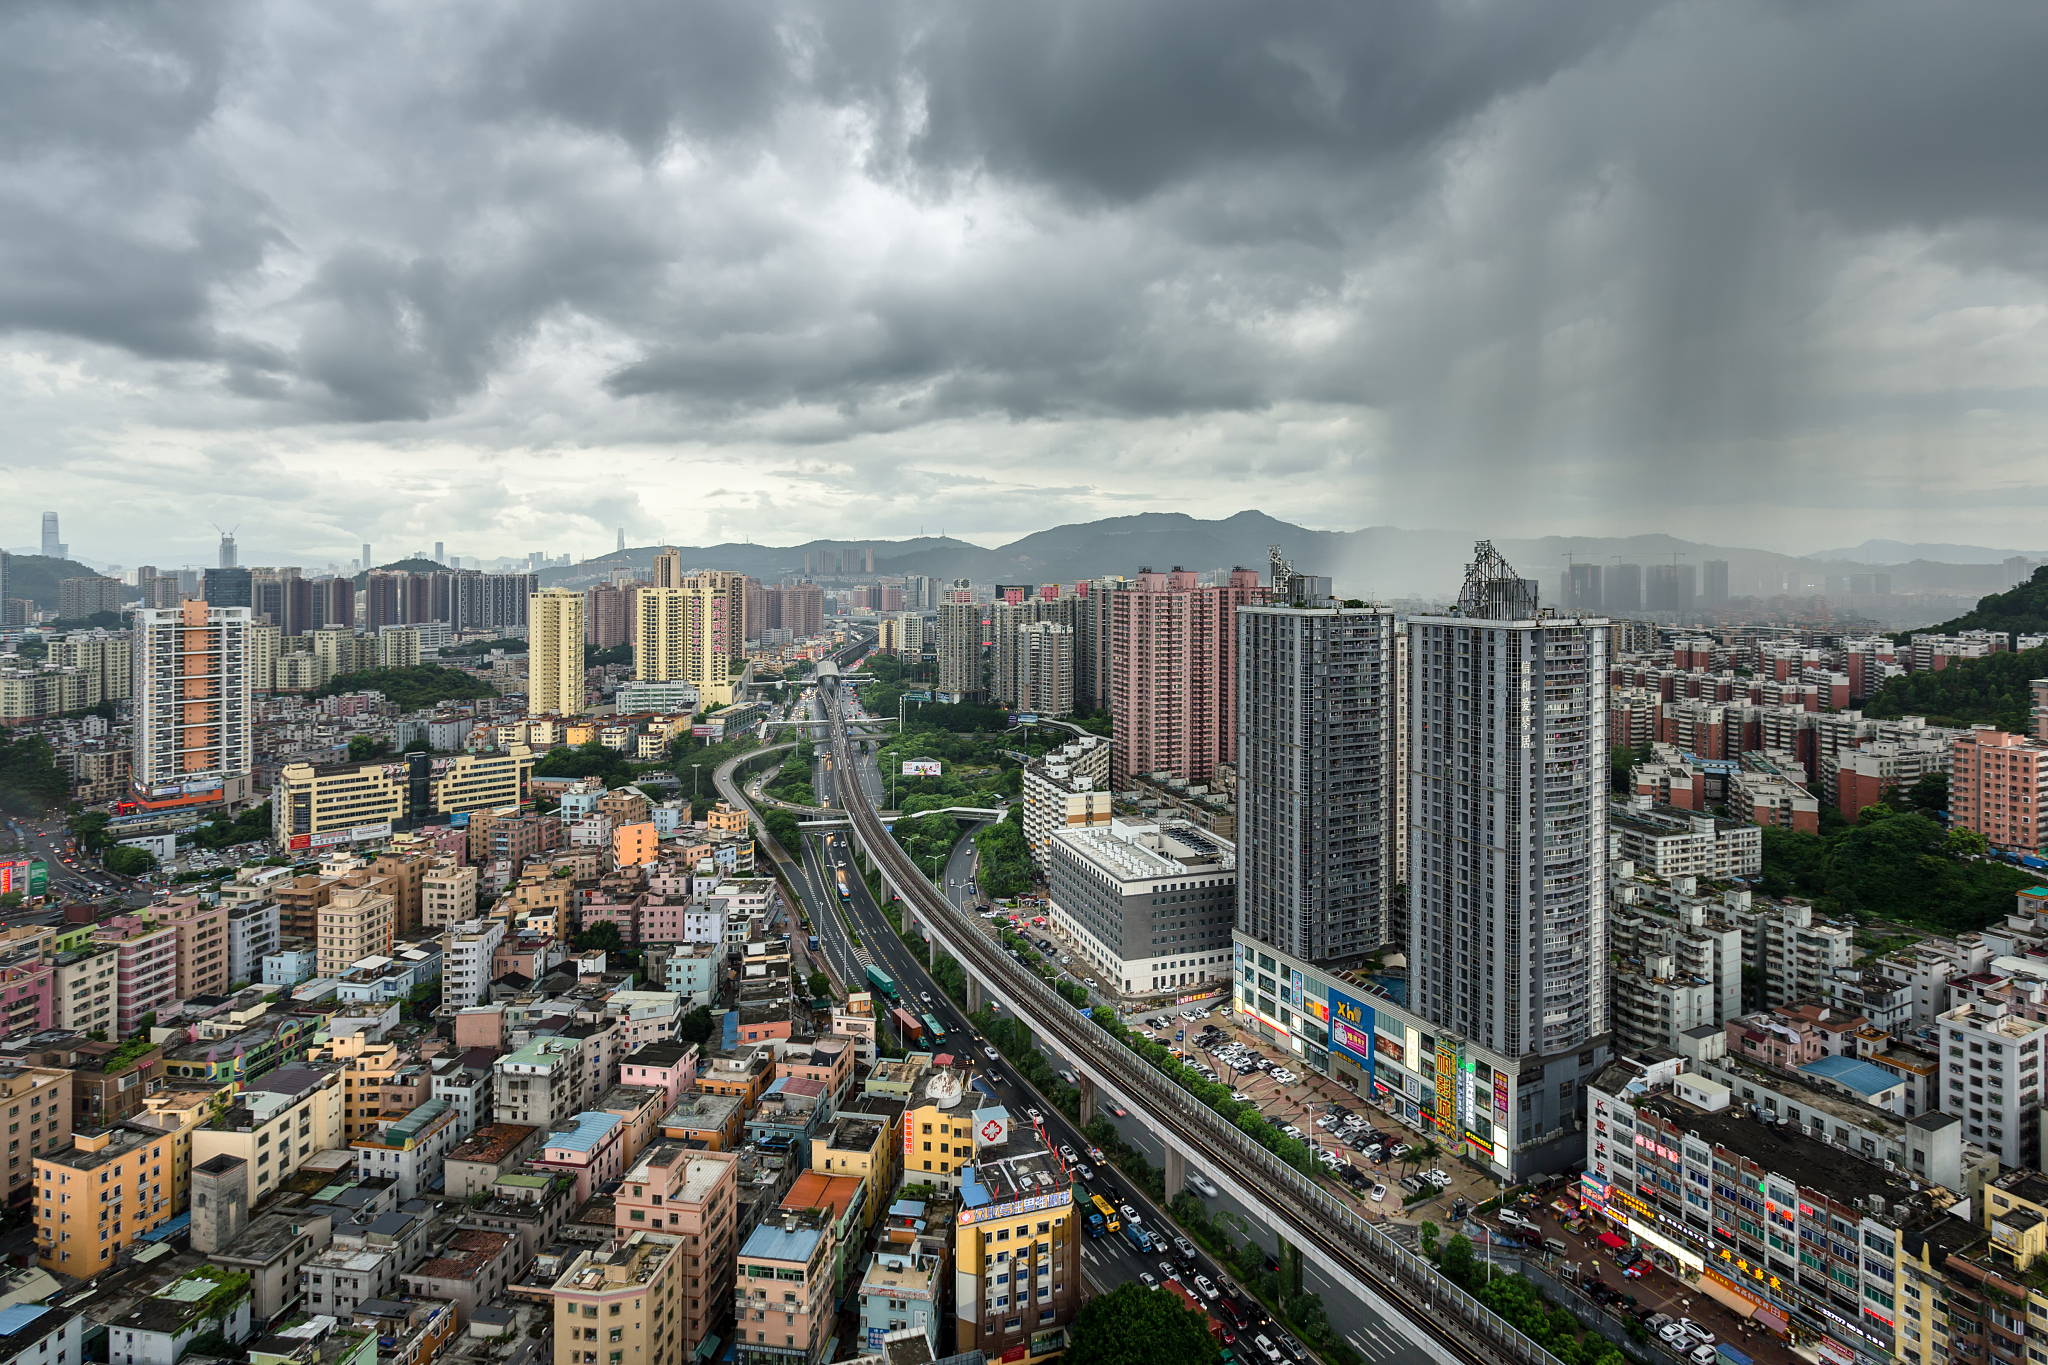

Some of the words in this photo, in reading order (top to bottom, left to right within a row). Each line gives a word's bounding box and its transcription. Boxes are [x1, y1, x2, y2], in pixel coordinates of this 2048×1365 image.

[1495, 632, 1506, 790] SERVICE
[1521, 660, 1531, 749] 信和爱琴居
[1413, 832, 1421, 1004] MANSION
[1436, 1045, 1451, 1121] 一帆影城
